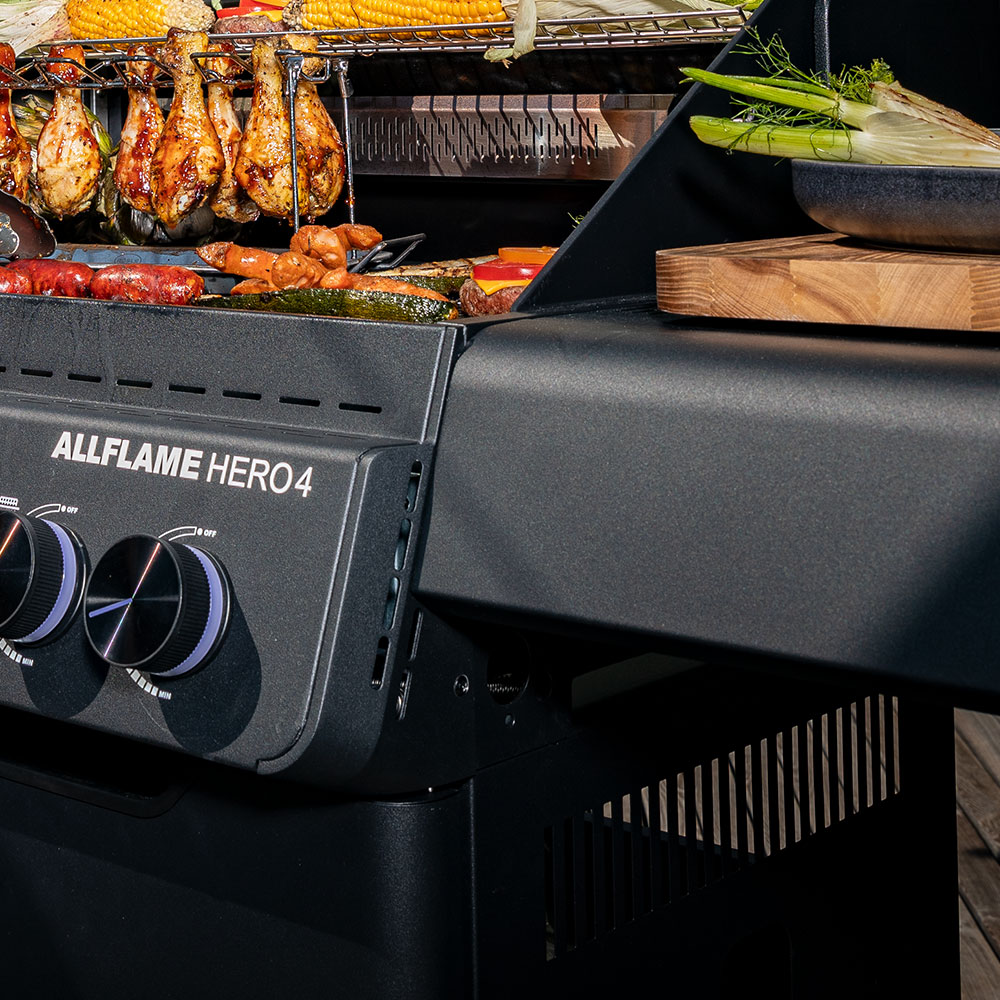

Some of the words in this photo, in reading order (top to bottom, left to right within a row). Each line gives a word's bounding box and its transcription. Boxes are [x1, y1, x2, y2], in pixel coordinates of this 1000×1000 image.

[51, 430, 204, 481] ALLFLAME
[205, 452, 293, 495] HERO
[294, 466, 314, 498] 4
[66, 506, 79, 514] OFF
[203, 529, 217, 538] OFF
